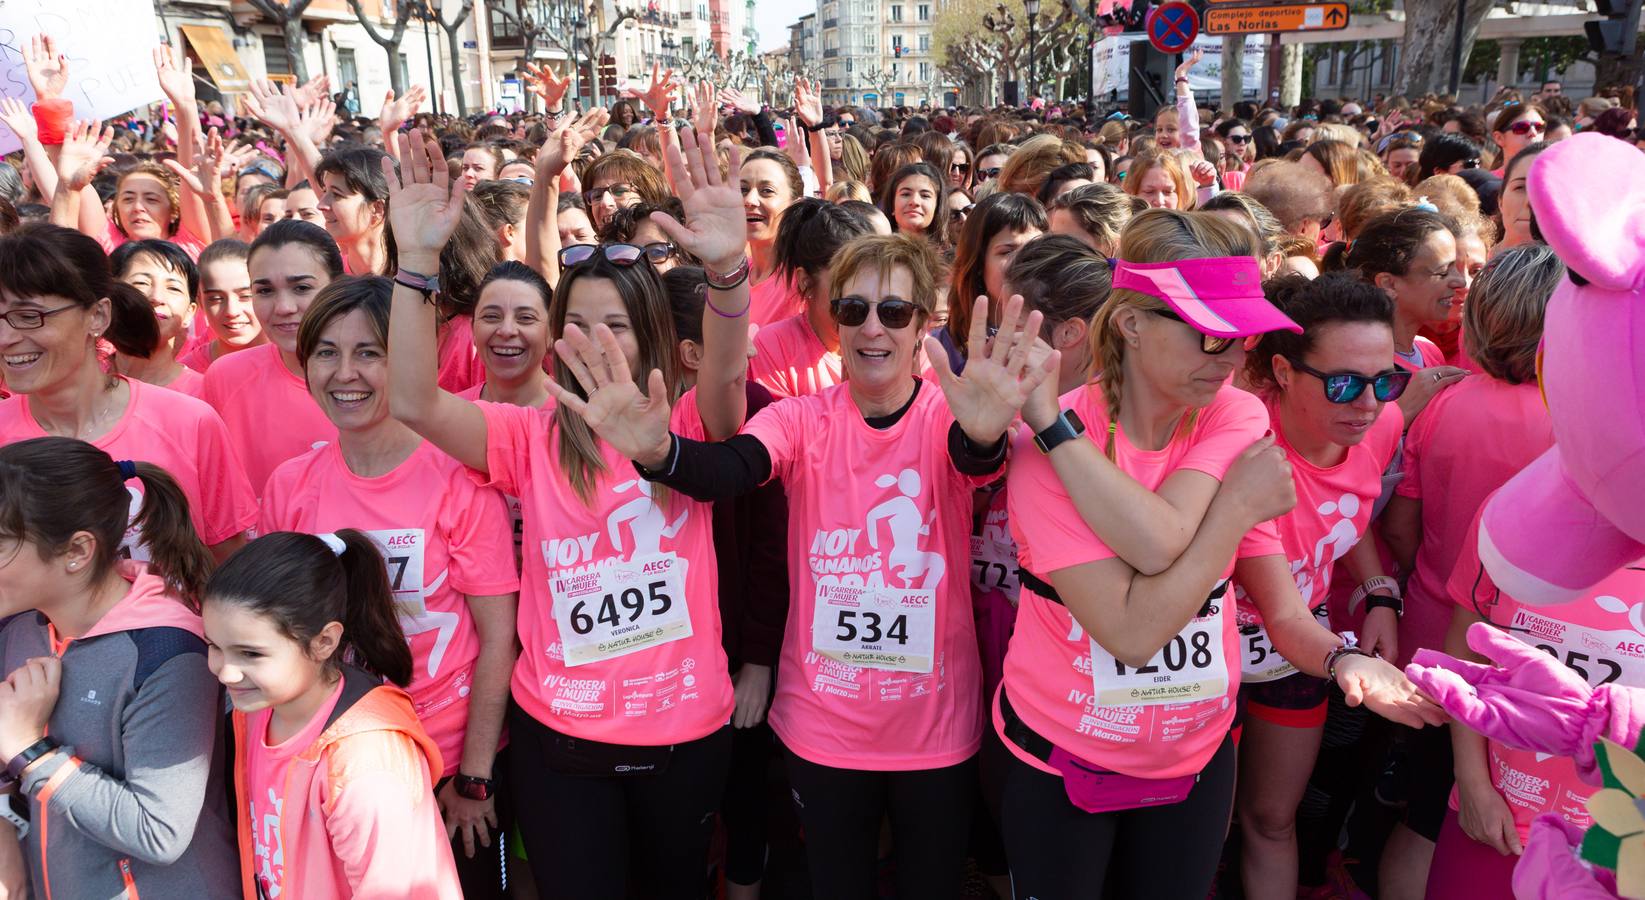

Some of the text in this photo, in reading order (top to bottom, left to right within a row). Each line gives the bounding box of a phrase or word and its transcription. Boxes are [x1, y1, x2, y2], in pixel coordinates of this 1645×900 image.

[1210, 8, 1301, 19] Complejo deportivo
[1210, 19, 1279, 31] Las Norias
[388, 535, 417, 545] AECC
[810, 528, 862, 556] HOY
[541, 531, 600, 568] HOY
[642, 559, 671, 573] AECC
[808, 551, 882, 575] GANAMOS
[556, 579, 567, 593] IV
[566, 571, 601, 585] CARRERA
[571, 579, 598, 592] MUJER
[819, 585, 863, 597] IV CARRERA
[833, 593, 859, 602] MUJER
[901, 595, 929, 604] AECC
[570, 580, 672, 635] 6495
[836, 610, 908, 645] 534
[1515, 612, 1566, 632] IV CARRERA
[611, 624, 640, 637] VERONICA
[1530, 623, 1561, 637] MUJER
[1616, 641, 1645, 654] AEC
[804, 651, 820, 665] IV
[823, 666, 857, 682] MUJER
[543, 674, 560, 688] IV
[560, 676, 607, 691] CARRERA
[811, 681, 825, 692] 31
[825, 685, 848, 697] Marzo
[562, 687, 600, 702] MUJER
[1068, 689, 1086, 703] IV
[1141, 687, 1166, 697] NATUR
[1168, 684, 1191, 694] HOUSE
[1091, 706, 1137, 725] MUJER
[1075, 722, 1091, 735] 31
[1092, 728, 1122, 742] Marzo
[1504, 773, 1543, 795] MUJER
